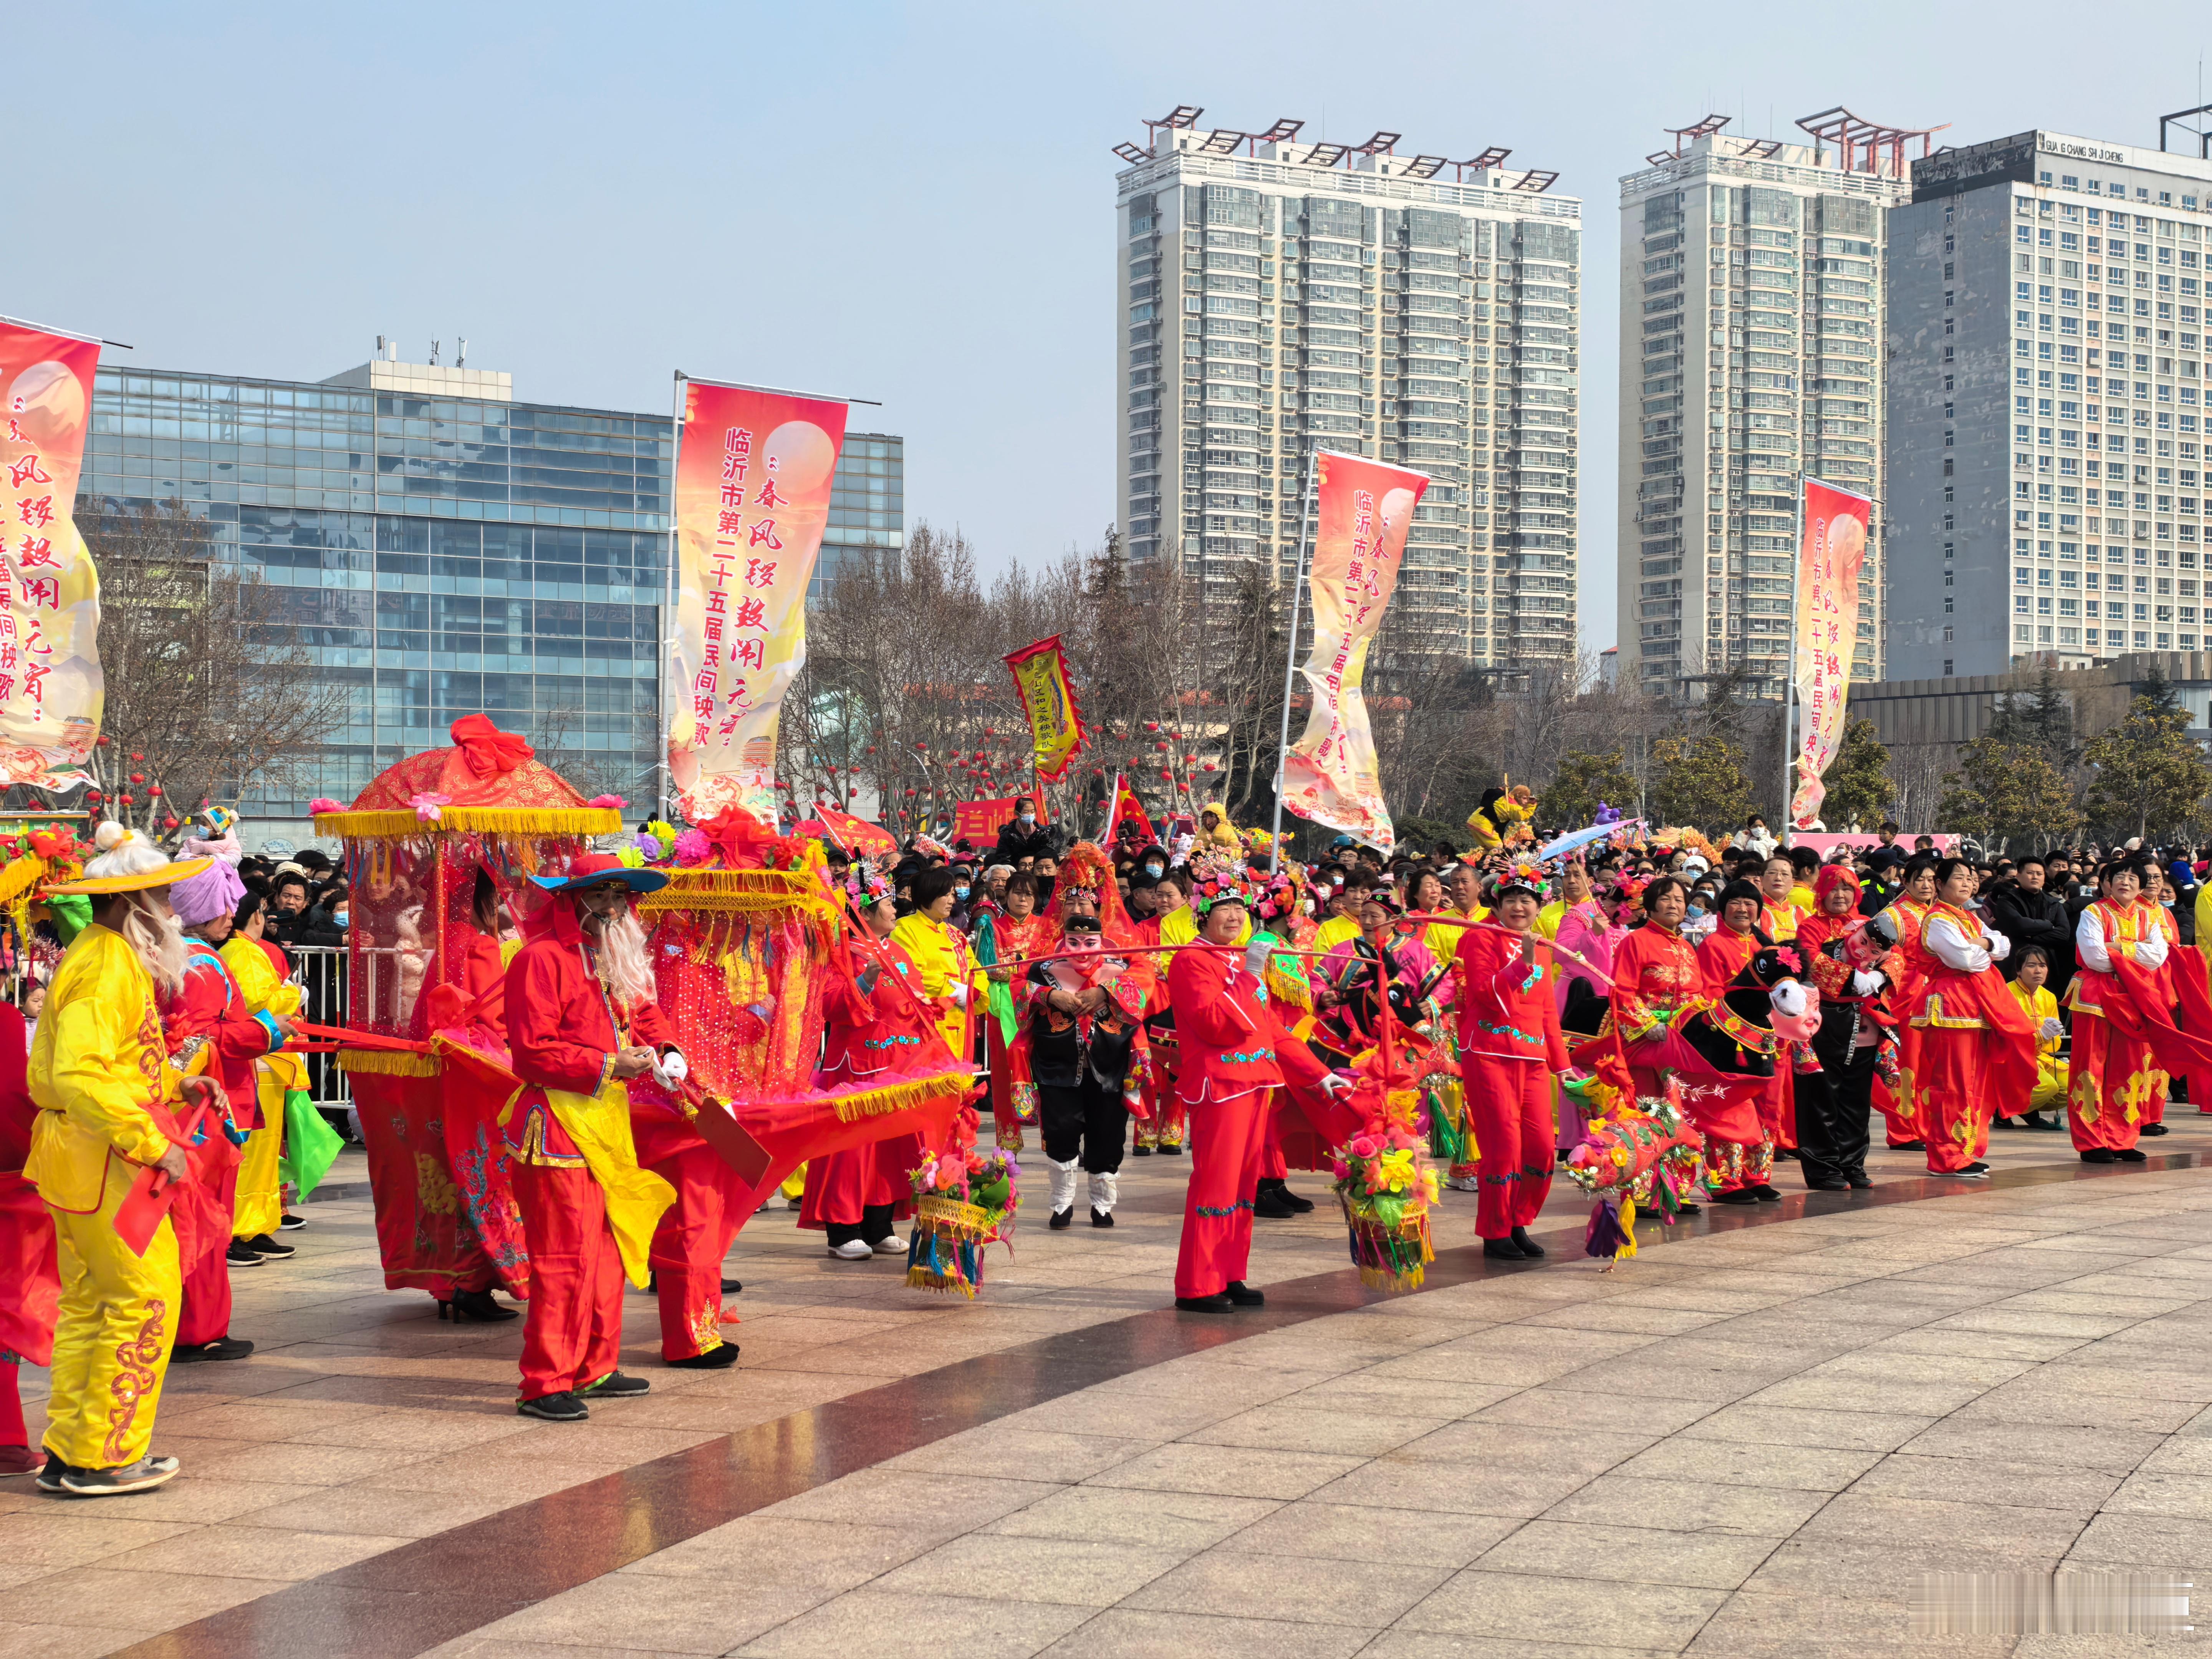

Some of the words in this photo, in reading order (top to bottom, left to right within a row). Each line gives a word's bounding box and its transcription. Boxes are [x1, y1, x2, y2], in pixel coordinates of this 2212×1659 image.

[2067, 144, 2086, 156] CHANG
[2105, 151, 2123, 163] CHENG
[694, 428, 752, 745] 临沂市第二十五届民间秧歌
